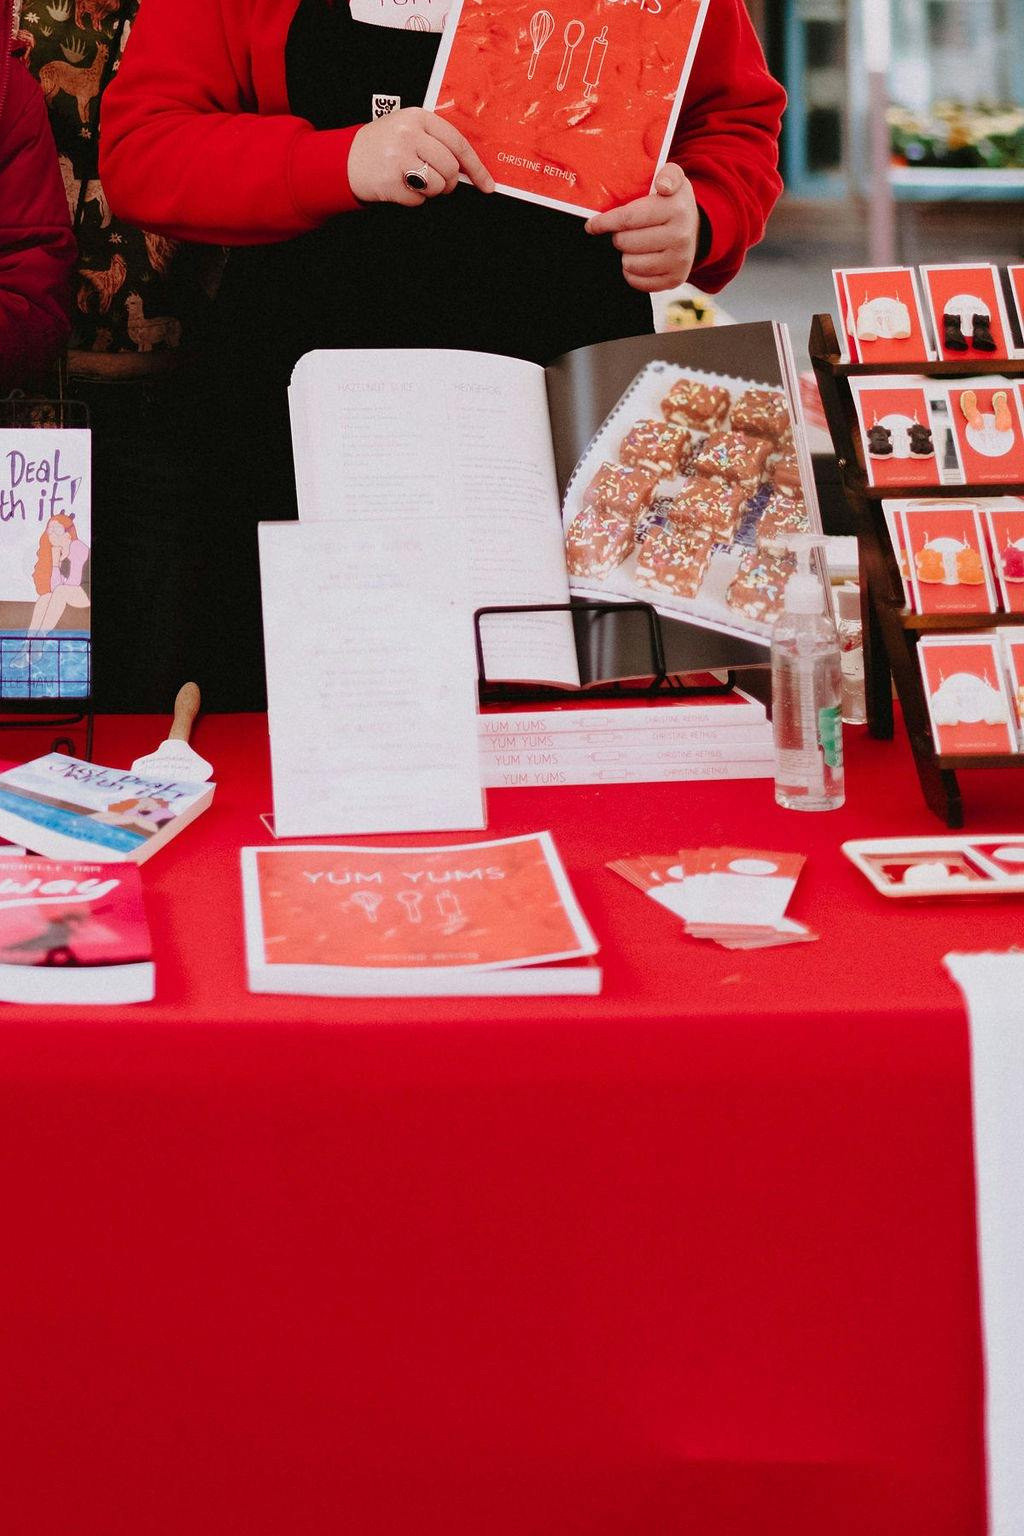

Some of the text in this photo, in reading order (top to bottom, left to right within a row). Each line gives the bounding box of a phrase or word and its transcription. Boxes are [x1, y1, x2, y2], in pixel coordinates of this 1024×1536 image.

[496, 152, 578, 183] CHRISTINE RETHUS
[483, 720, 510, 732] YUM
[514, 718, 547, 732] YUMS
[490, 736, 518, 748] YUM
[522, 736, 554, 748] YUMS
[494, 754, 522, 766] YUM
[526, 752, 558, 765] YUMS
[502, 772, 530, 784] YUM
[534, 770, 567, 784] YUMS
[303, 866, 506, 886] YUM YUMS
